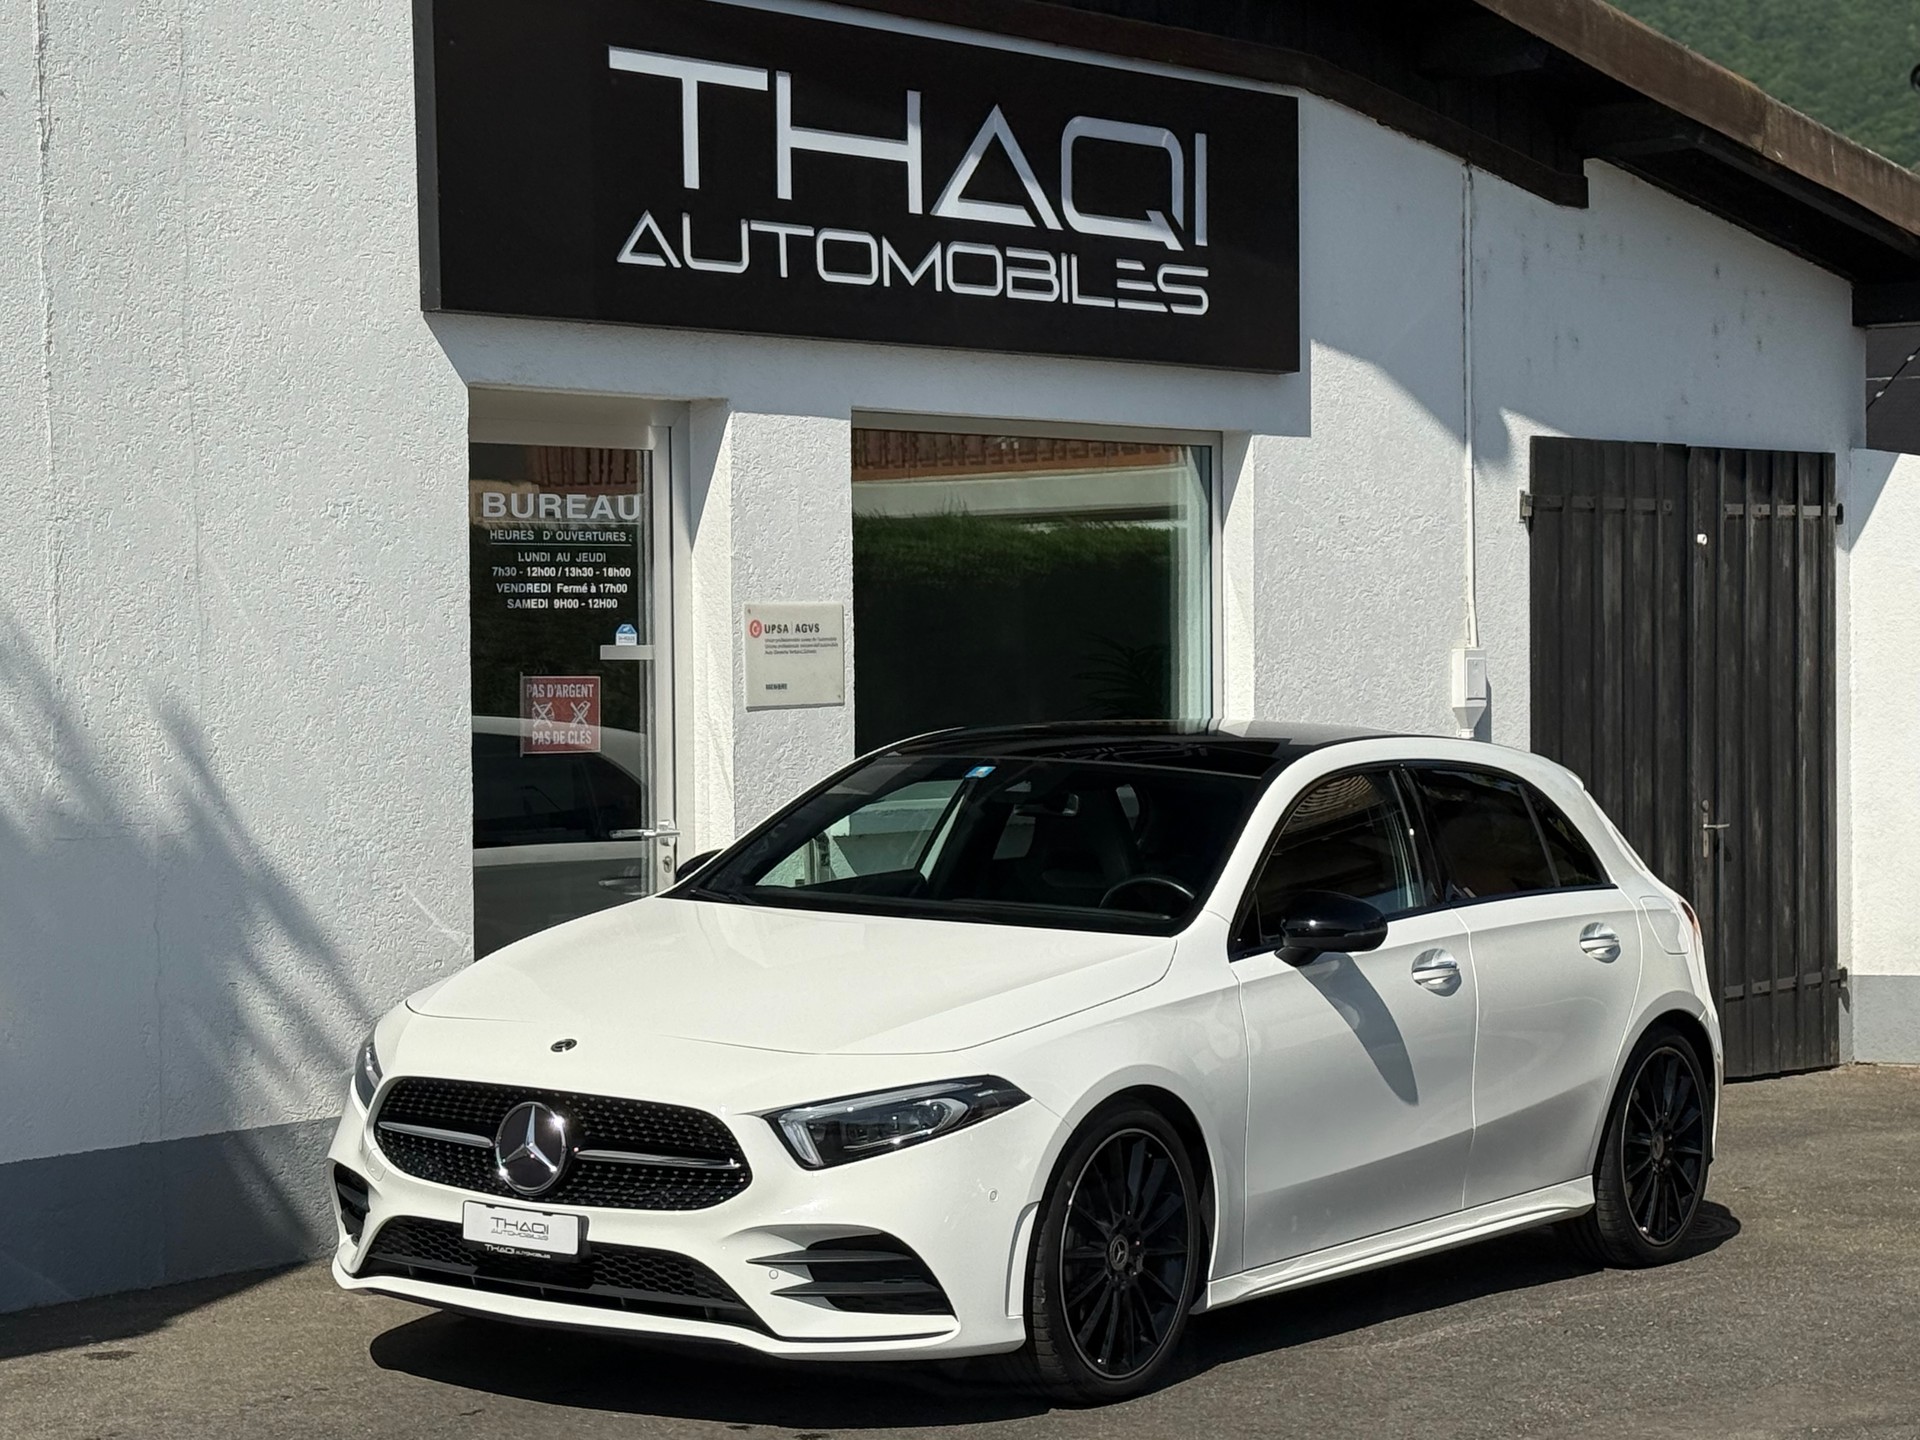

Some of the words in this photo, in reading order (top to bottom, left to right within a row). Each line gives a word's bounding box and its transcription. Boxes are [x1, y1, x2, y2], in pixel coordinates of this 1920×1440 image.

[608, 45, 1208, 250] THAQI
[616, 210, 1209, 315] AUTOMOBILES
[482, 492, 641, 520] BUREAU
[490, 530, 535, 541] HEURES
[518, 552, 550, 562] LUNDI
[556, 552, 571, 562] AU
[575, 552, 606, 562] JEUDI
[492, 567, 517, 577] 7h30
[526, 567, 556, 578] 12h00
[564, 567, 594, 578] 13h30
[496, 583, 551, 593] VENDREDI
[556, 583, 588, 594] Fermé
[590, 583, 597, 594] à
[600, 584, 628, 594] 17h00
[507, 599, 549, 609] SAMEDI
[553, 599, 579, 609] 9H00
[588, 599, 618, 609] 12H00
[764, 624, 789, 634] UPSA
[795, 624, 820, 633] AGVS
[526, 684, 545, 698] PAS
[547, 683, 594, 698] D'ARGENT
[532, 731, 551, 745] PAS
[553, 731, 566, 745] DE
[490, 1216, 550, 1235] THAQI
[484, 1244, 515, 1255] THAQI
